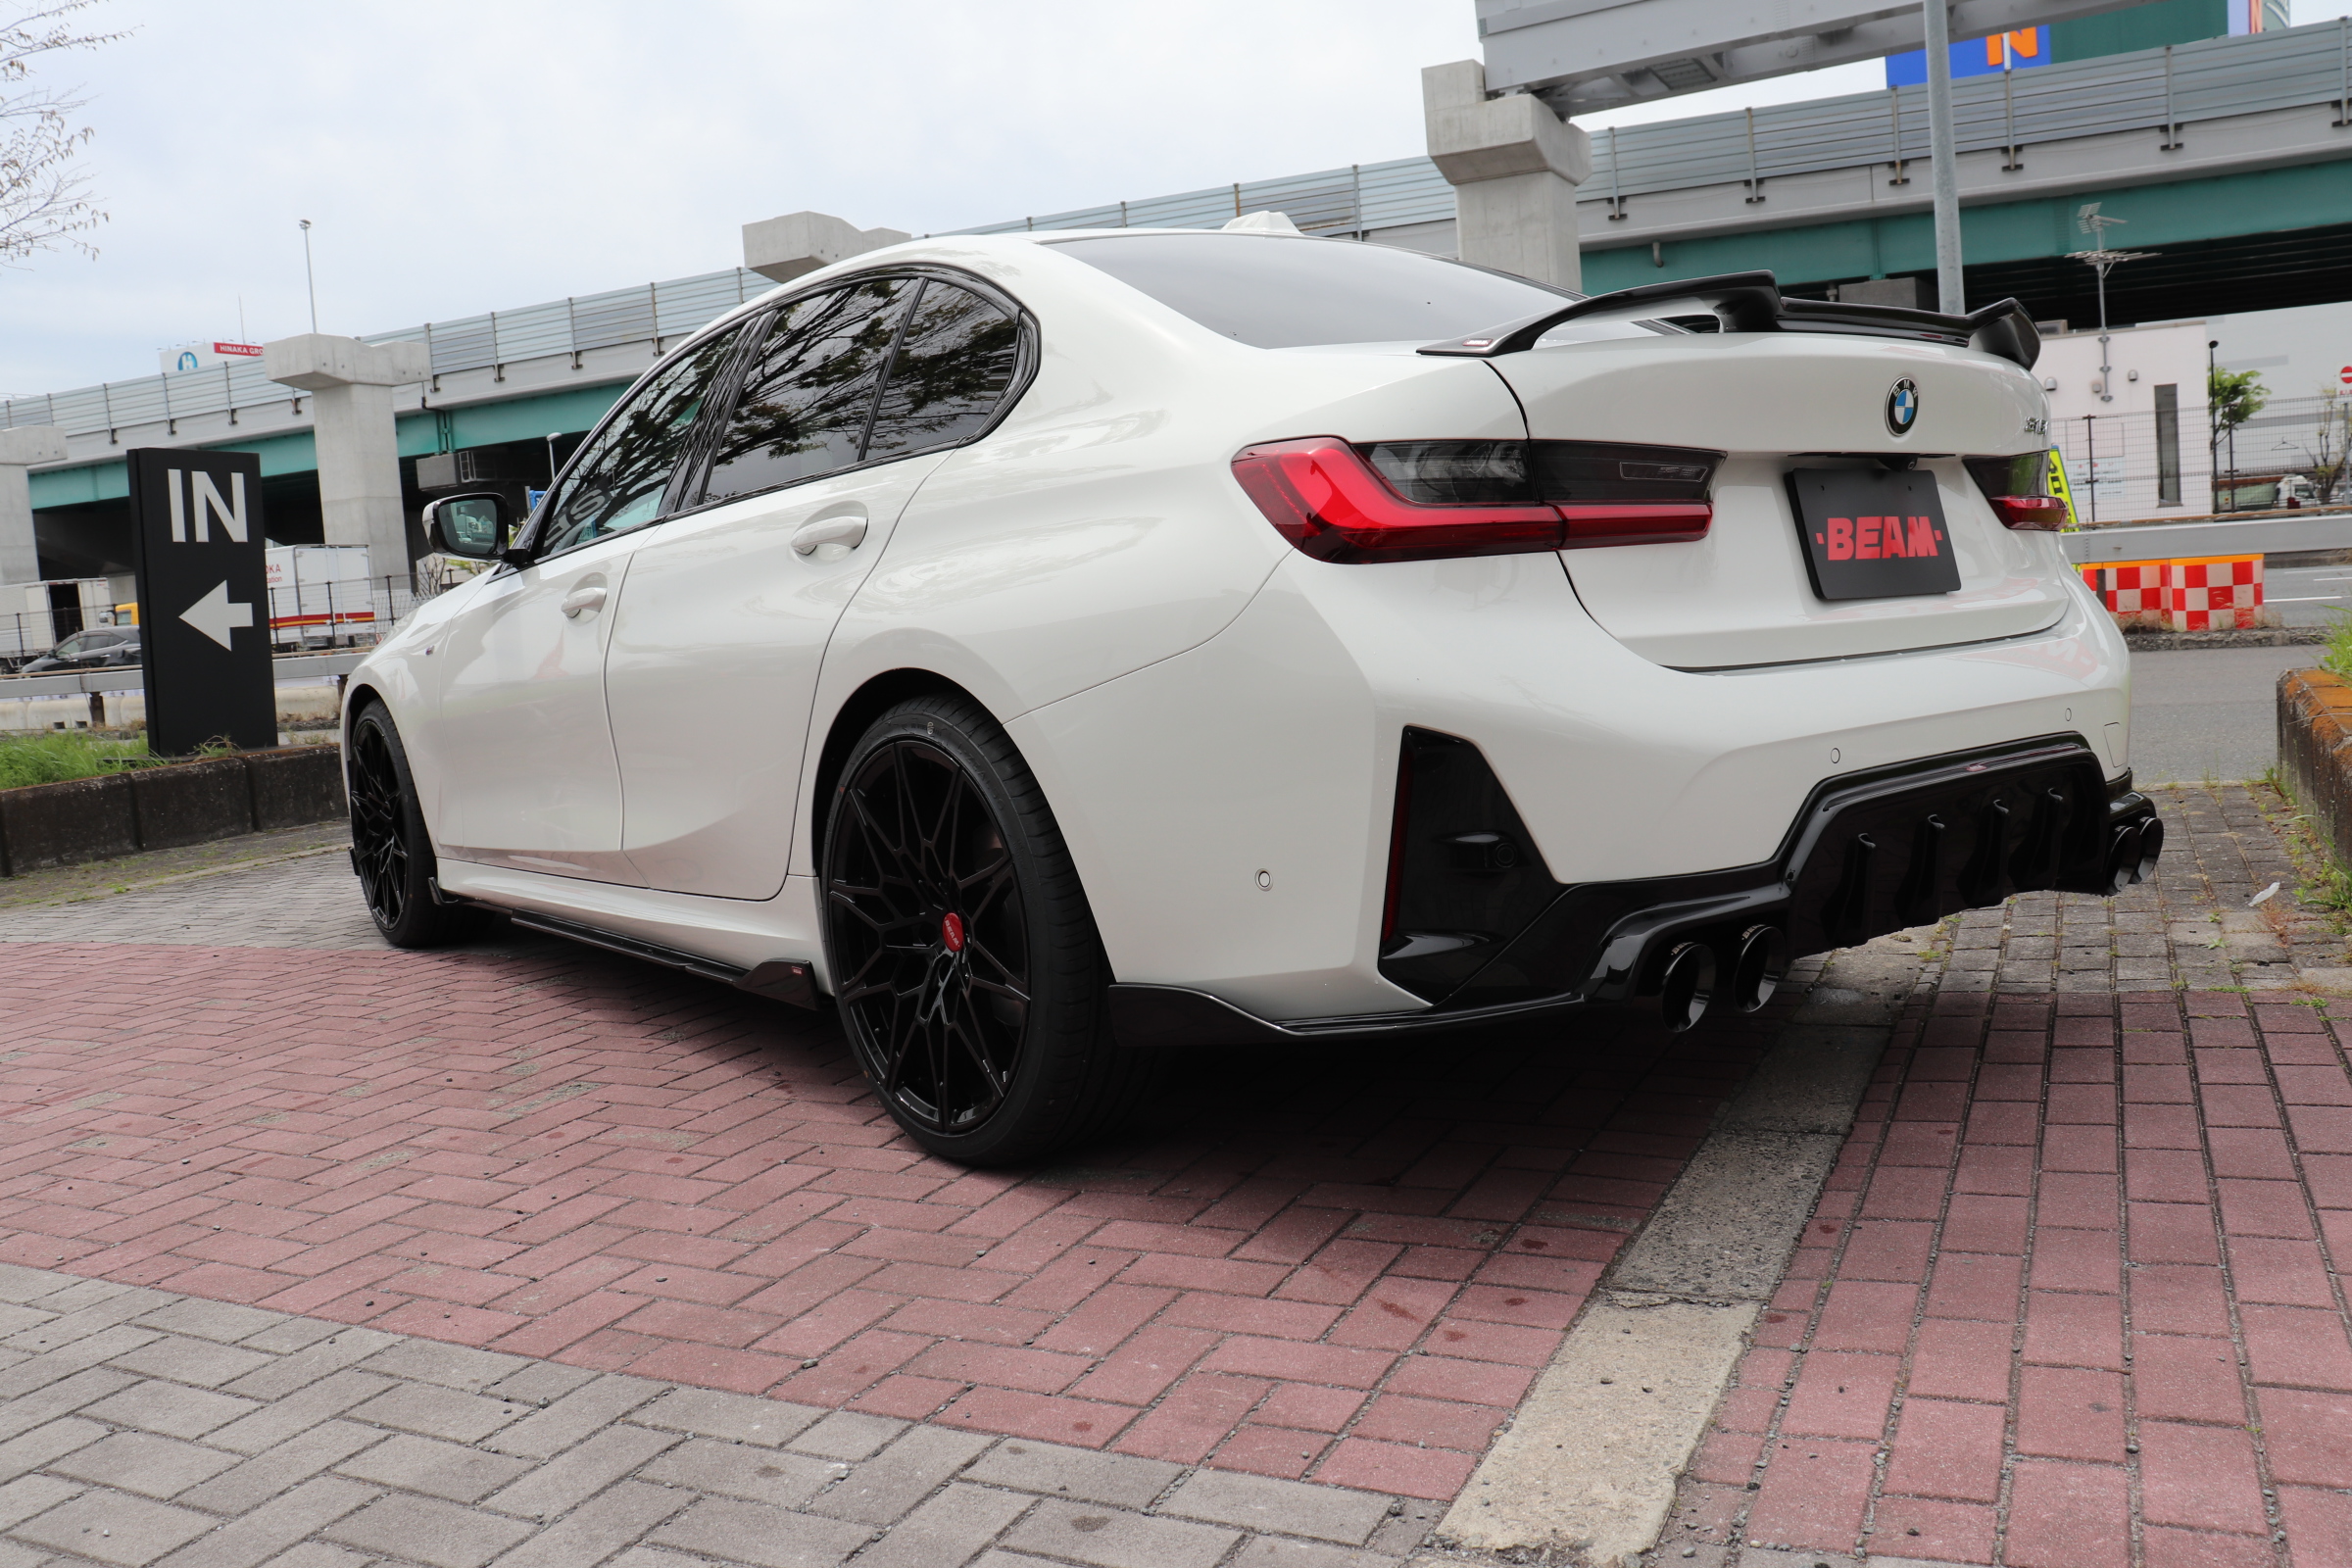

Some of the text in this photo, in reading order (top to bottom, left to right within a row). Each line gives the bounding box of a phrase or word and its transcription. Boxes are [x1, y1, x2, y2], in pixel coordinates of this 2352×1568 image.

[220, 344, 248, 354] HINAKA
[168, 468, 249, 543] IN
[1827, 515, 1938, 562] BEAM
